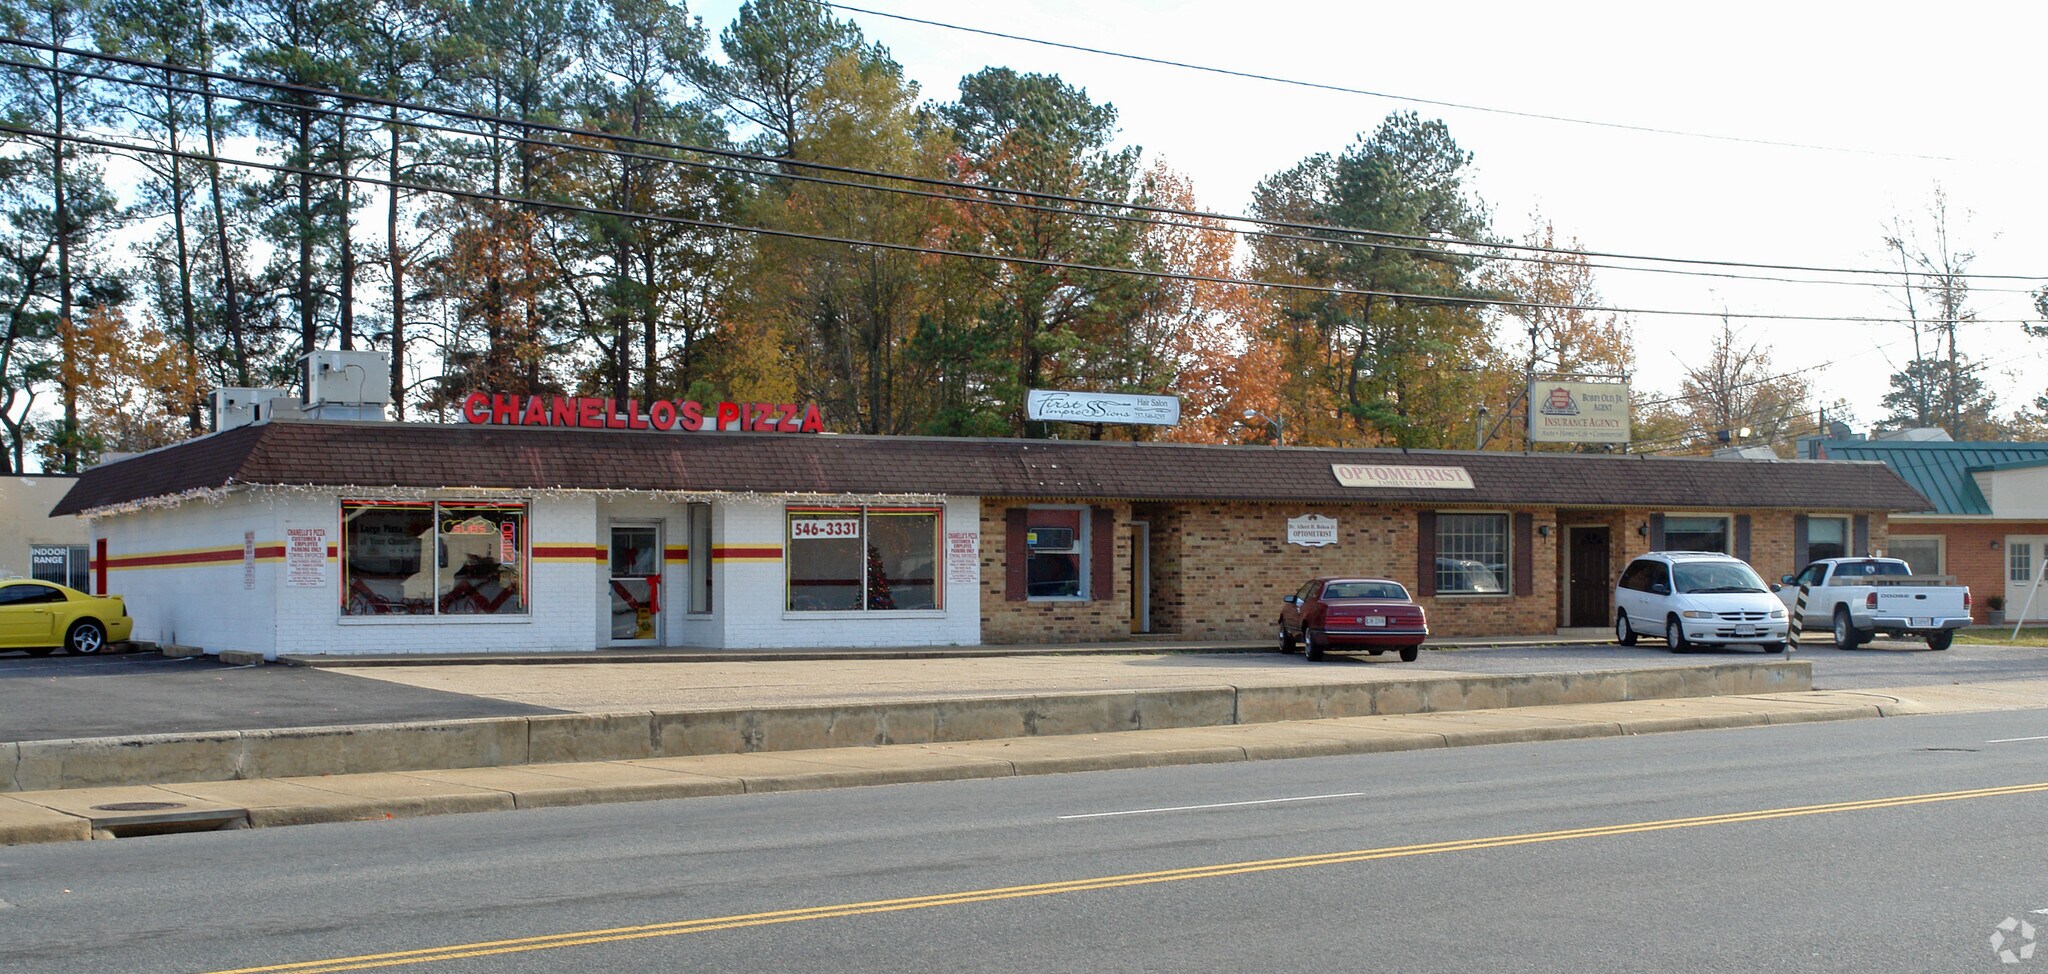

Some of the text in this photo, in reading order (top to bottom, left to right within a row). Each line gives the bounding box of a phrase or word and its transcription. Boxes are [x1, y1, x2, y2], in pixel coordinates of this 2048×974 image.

[1582, 393, 1600, 402] BOBBY
[1037, 393, 1083, 417] First
[1137, 398, 1169, 407] Hair Salon
[1593, 403, 1613, 412] AGENT
[464, 393, 826, 434] CHANELLO'S PIZZA
[1544, 417, 1620, 428] INSURANCE AGENCY
[1338, 466, 1465, 482] OPTOMETRIST
[452, 524, 487, 533] SUBS
[31, 548, 67, 556] INDOOR
[33, 556, 64, 564] RANGE
